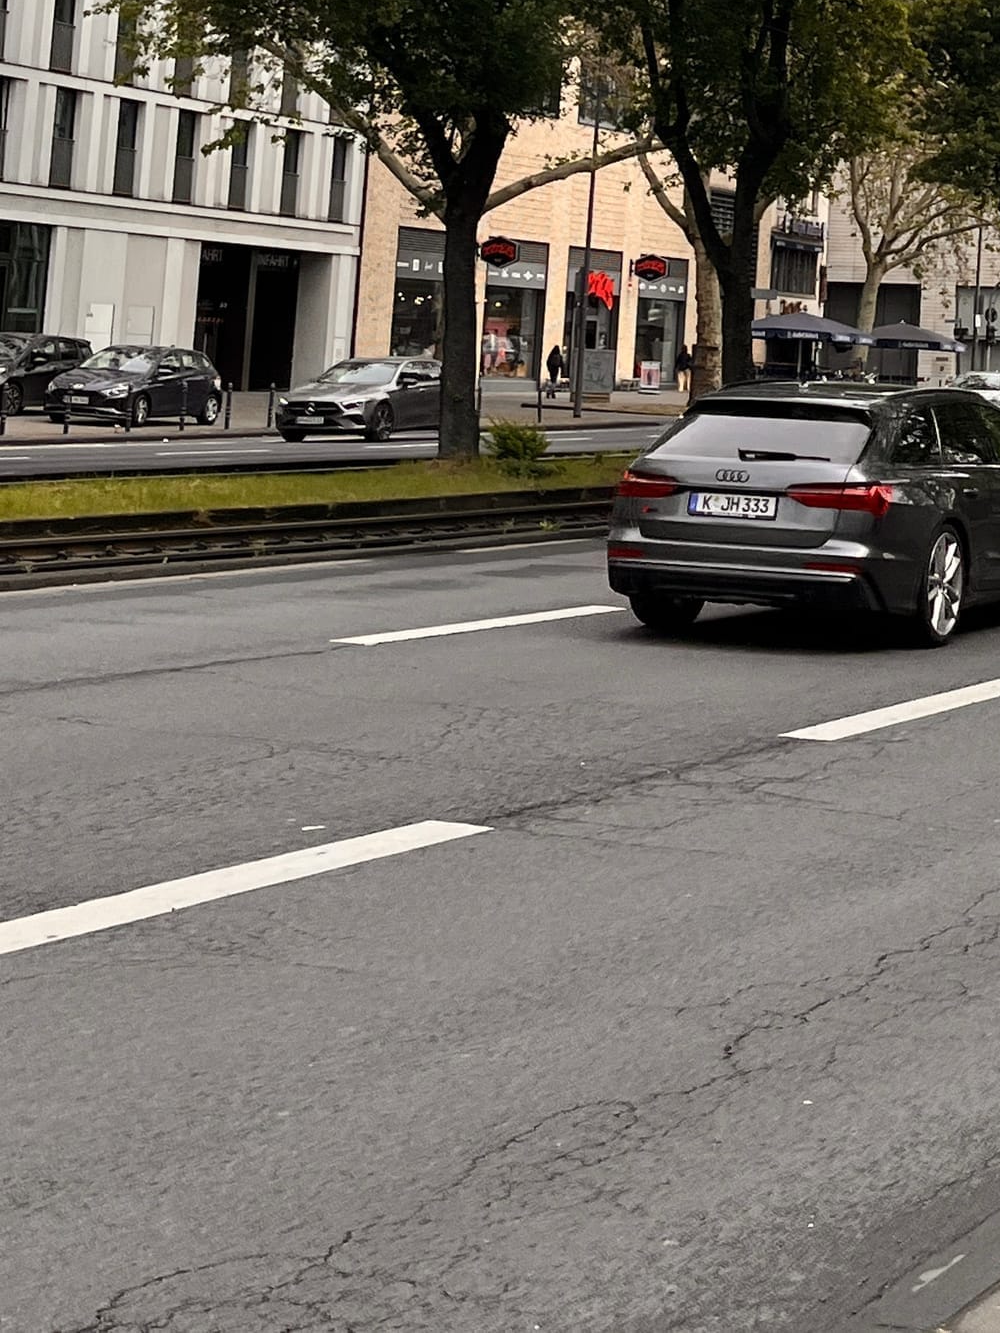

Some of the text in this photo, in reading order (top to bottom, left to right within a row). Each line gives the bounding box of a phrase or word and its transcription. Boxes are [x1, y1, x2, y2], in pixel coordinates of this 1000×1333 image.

[702, 495, 770, 514] K JH 333
